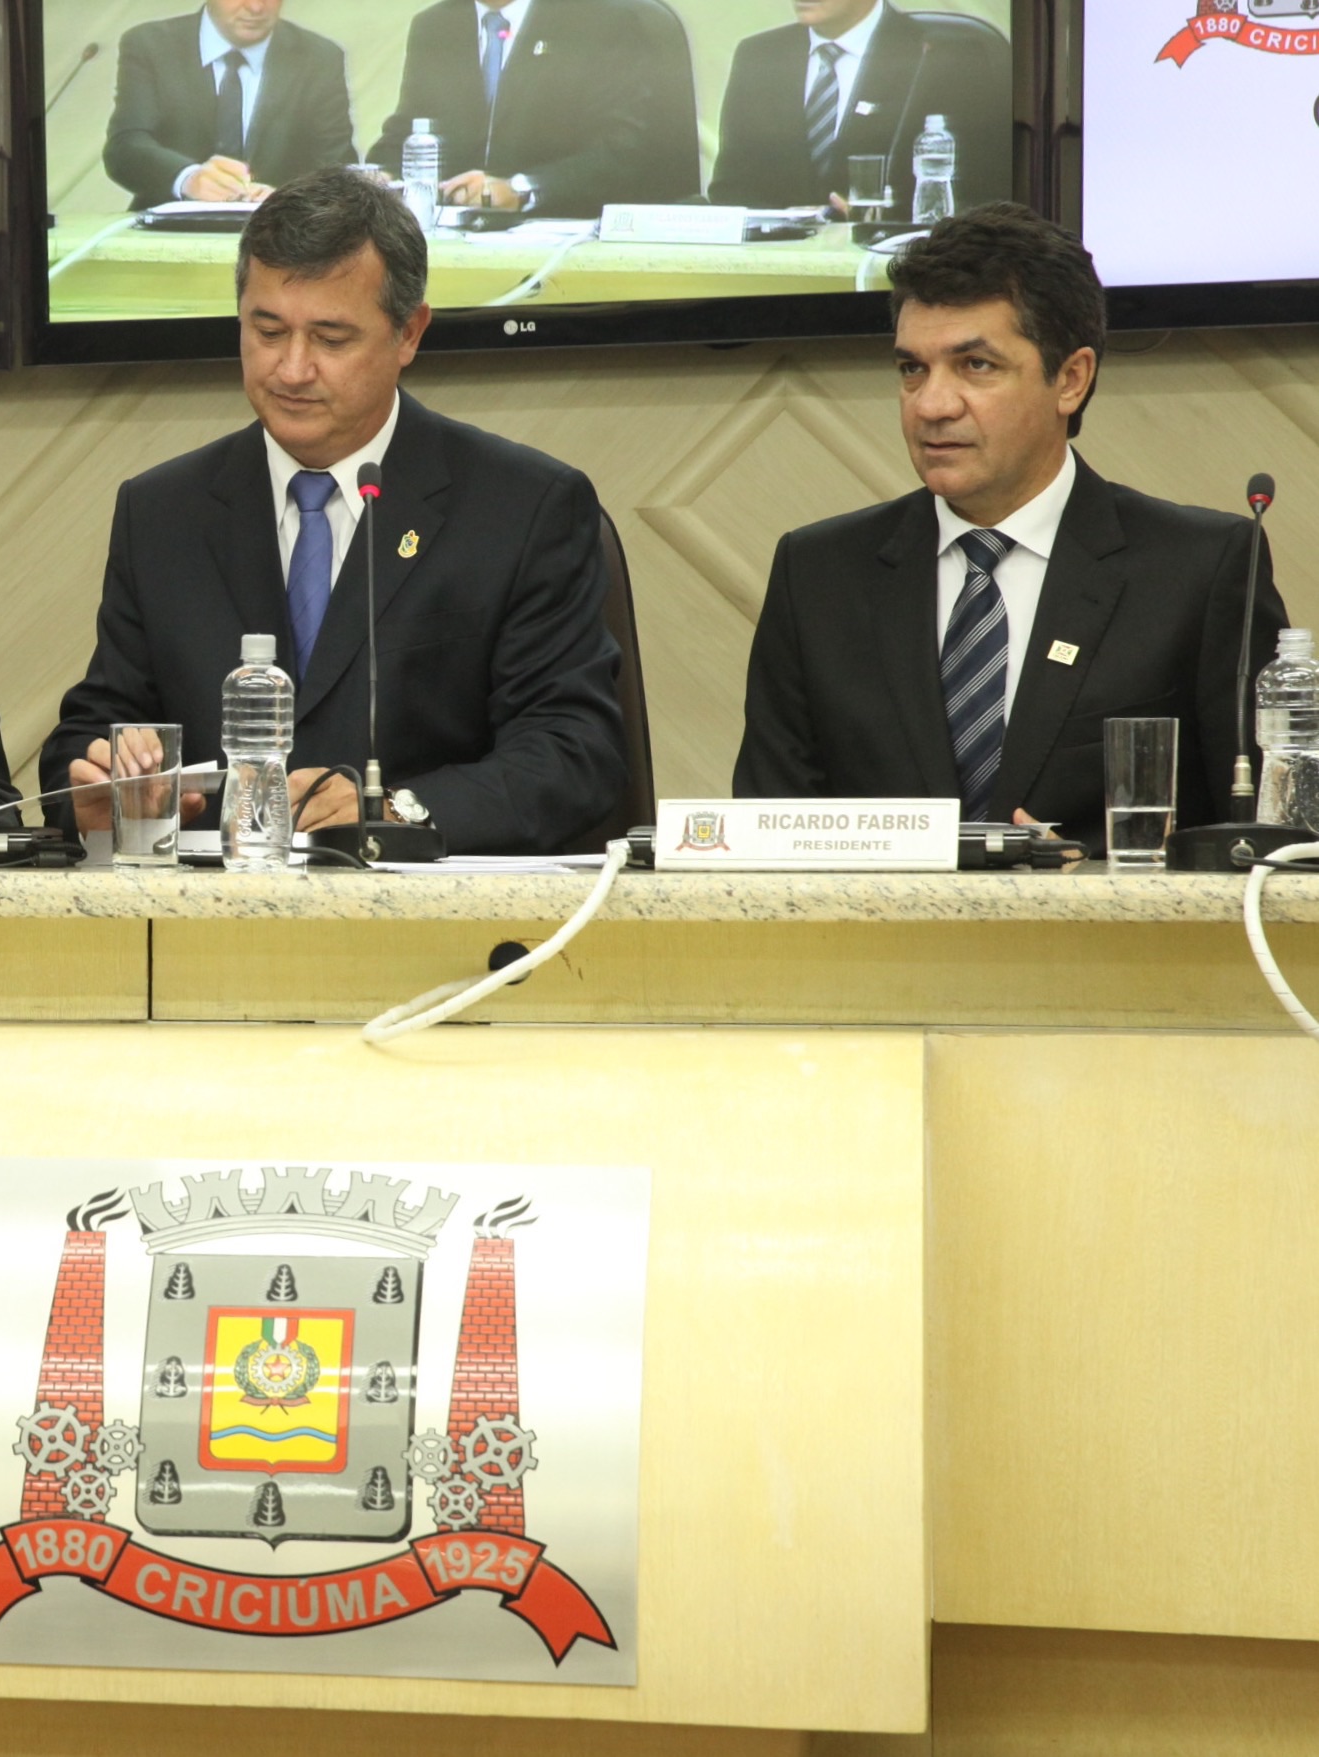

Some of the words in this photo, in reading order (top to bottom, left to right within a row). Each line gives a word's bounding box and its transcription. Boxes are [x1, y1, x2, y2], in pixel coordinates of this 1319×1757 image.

[1195, 18, 1241, 34] 1880
[520, 321, 536, 332] LG
[758, 814, 850, 831] RICARDO
[857, 814, 931, 831] FABRIS
[793, 840, 893, 851] PRESIDENTE
[13, 1527, 114, 1572] 1880
[425, 1541, 532, 1587] 1925
[134, 1562, 410, 1626] CRICIÚMA
